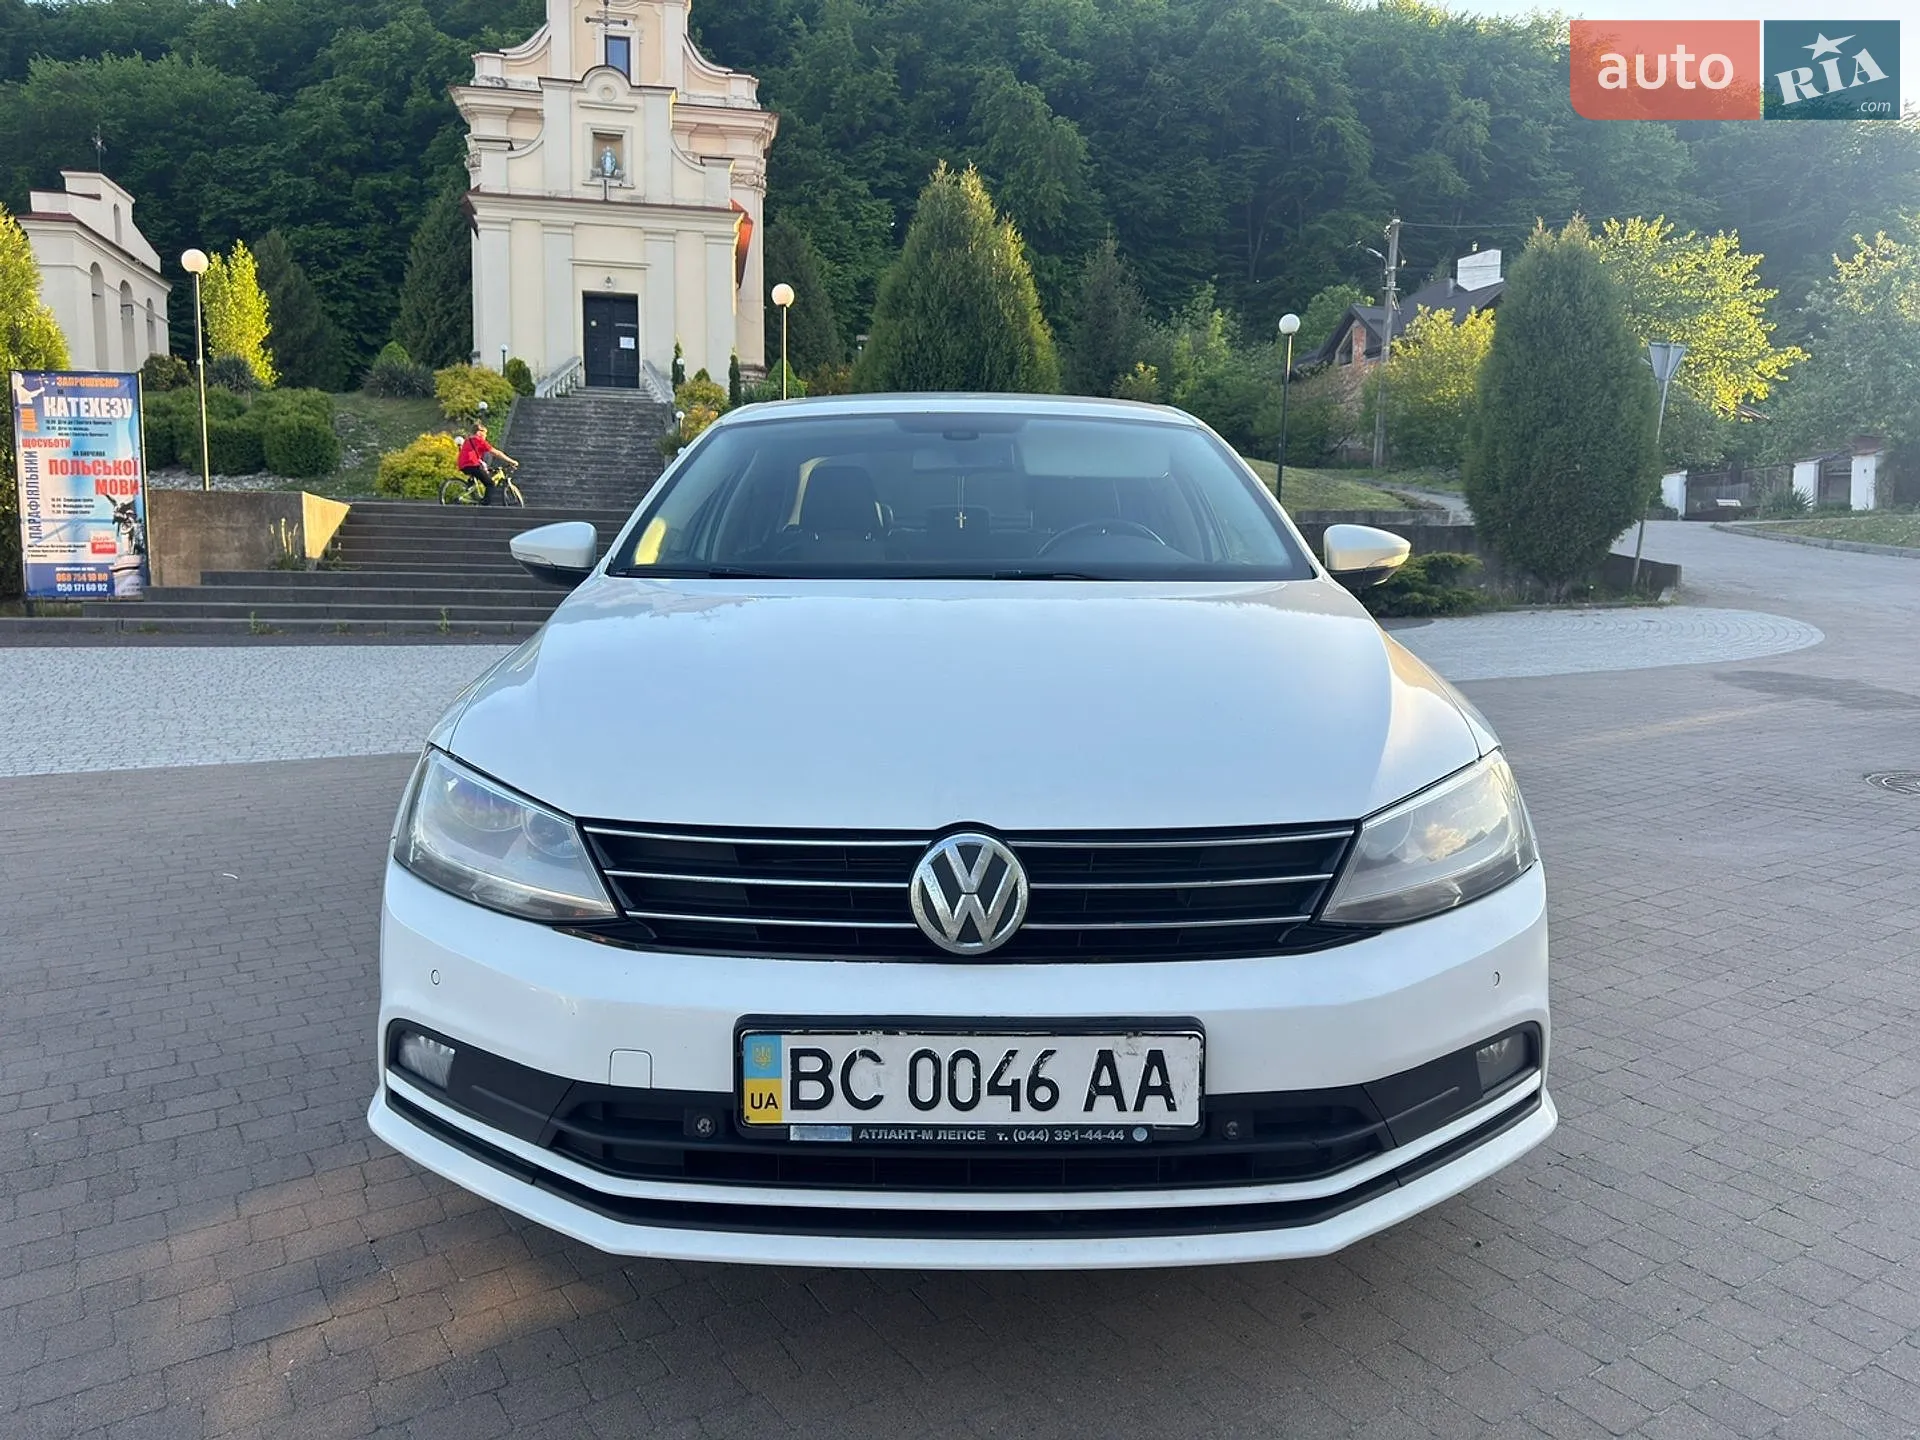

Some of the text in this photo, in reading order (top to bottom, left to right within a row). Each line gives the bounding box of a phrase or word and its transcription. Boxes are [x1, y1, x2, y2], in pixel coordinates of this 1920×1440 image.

[43, 396, 133, 418] КАТЕХЕЗУ
[21, 438, 71, 449] ЩОСУБОТИ
[48, 457, 139, 475] ПОЛЬСЬКОЇ
[95, 478, 139, 495] МОВИ
[790, 1048, 1178, 1112] BC 0046 AA
[750, 1092, 778, 1110] UA
[858, 1128, 934, 1140] АТЛАНТ-М
[936, 1128, 986, 1140] ЛЕПСЕ
[1013, 1129, 1050, 1142] (044)
[1054, 1129, 1125, 1141] 391-44-44
